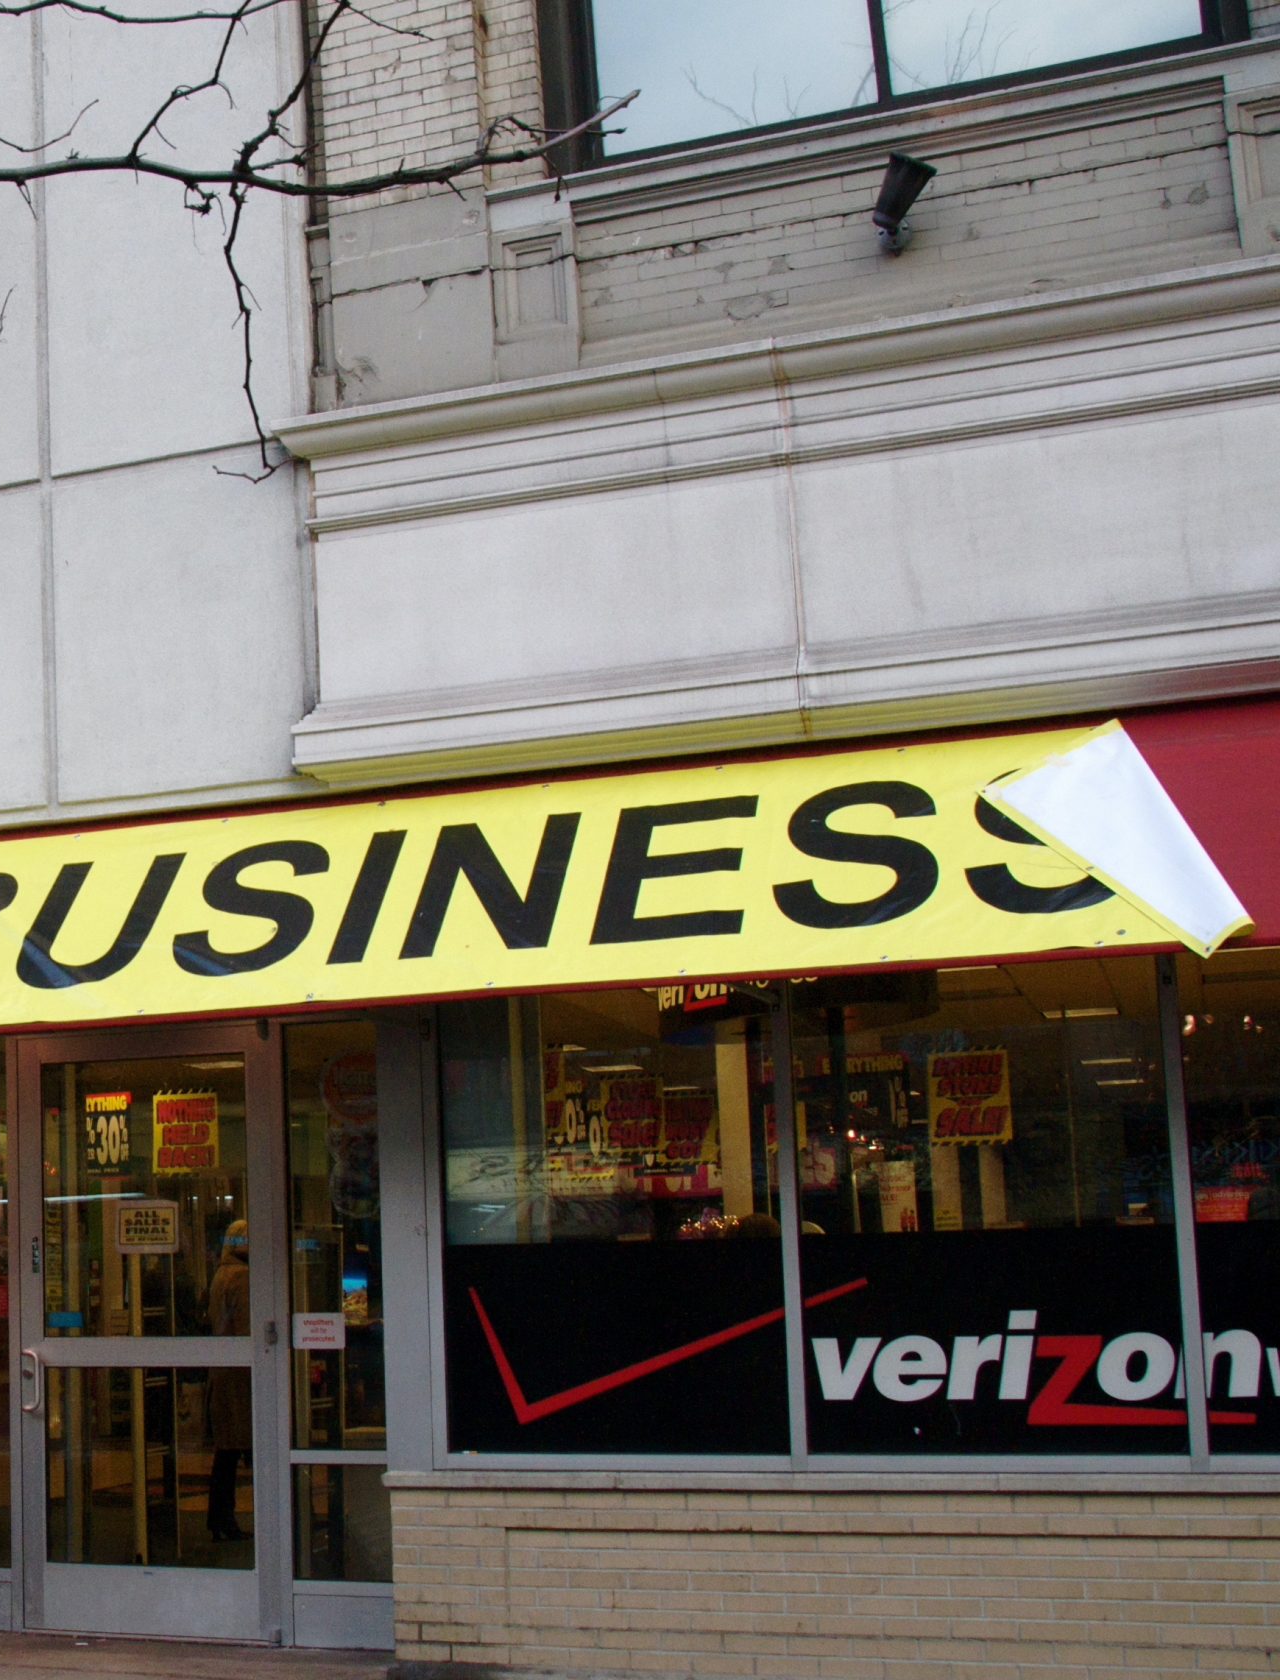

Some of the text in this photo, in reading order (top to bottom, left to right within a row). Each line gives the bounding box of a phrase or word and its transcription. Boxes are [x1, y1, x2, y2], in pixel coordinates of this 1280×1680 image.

[134, 1210, 160, 1218] ALL
[124, 1218, 170, 1226] SALES
[125, 1226, 169, 1234] FINAL
[811, 1310, 1261, 1425] verizon
